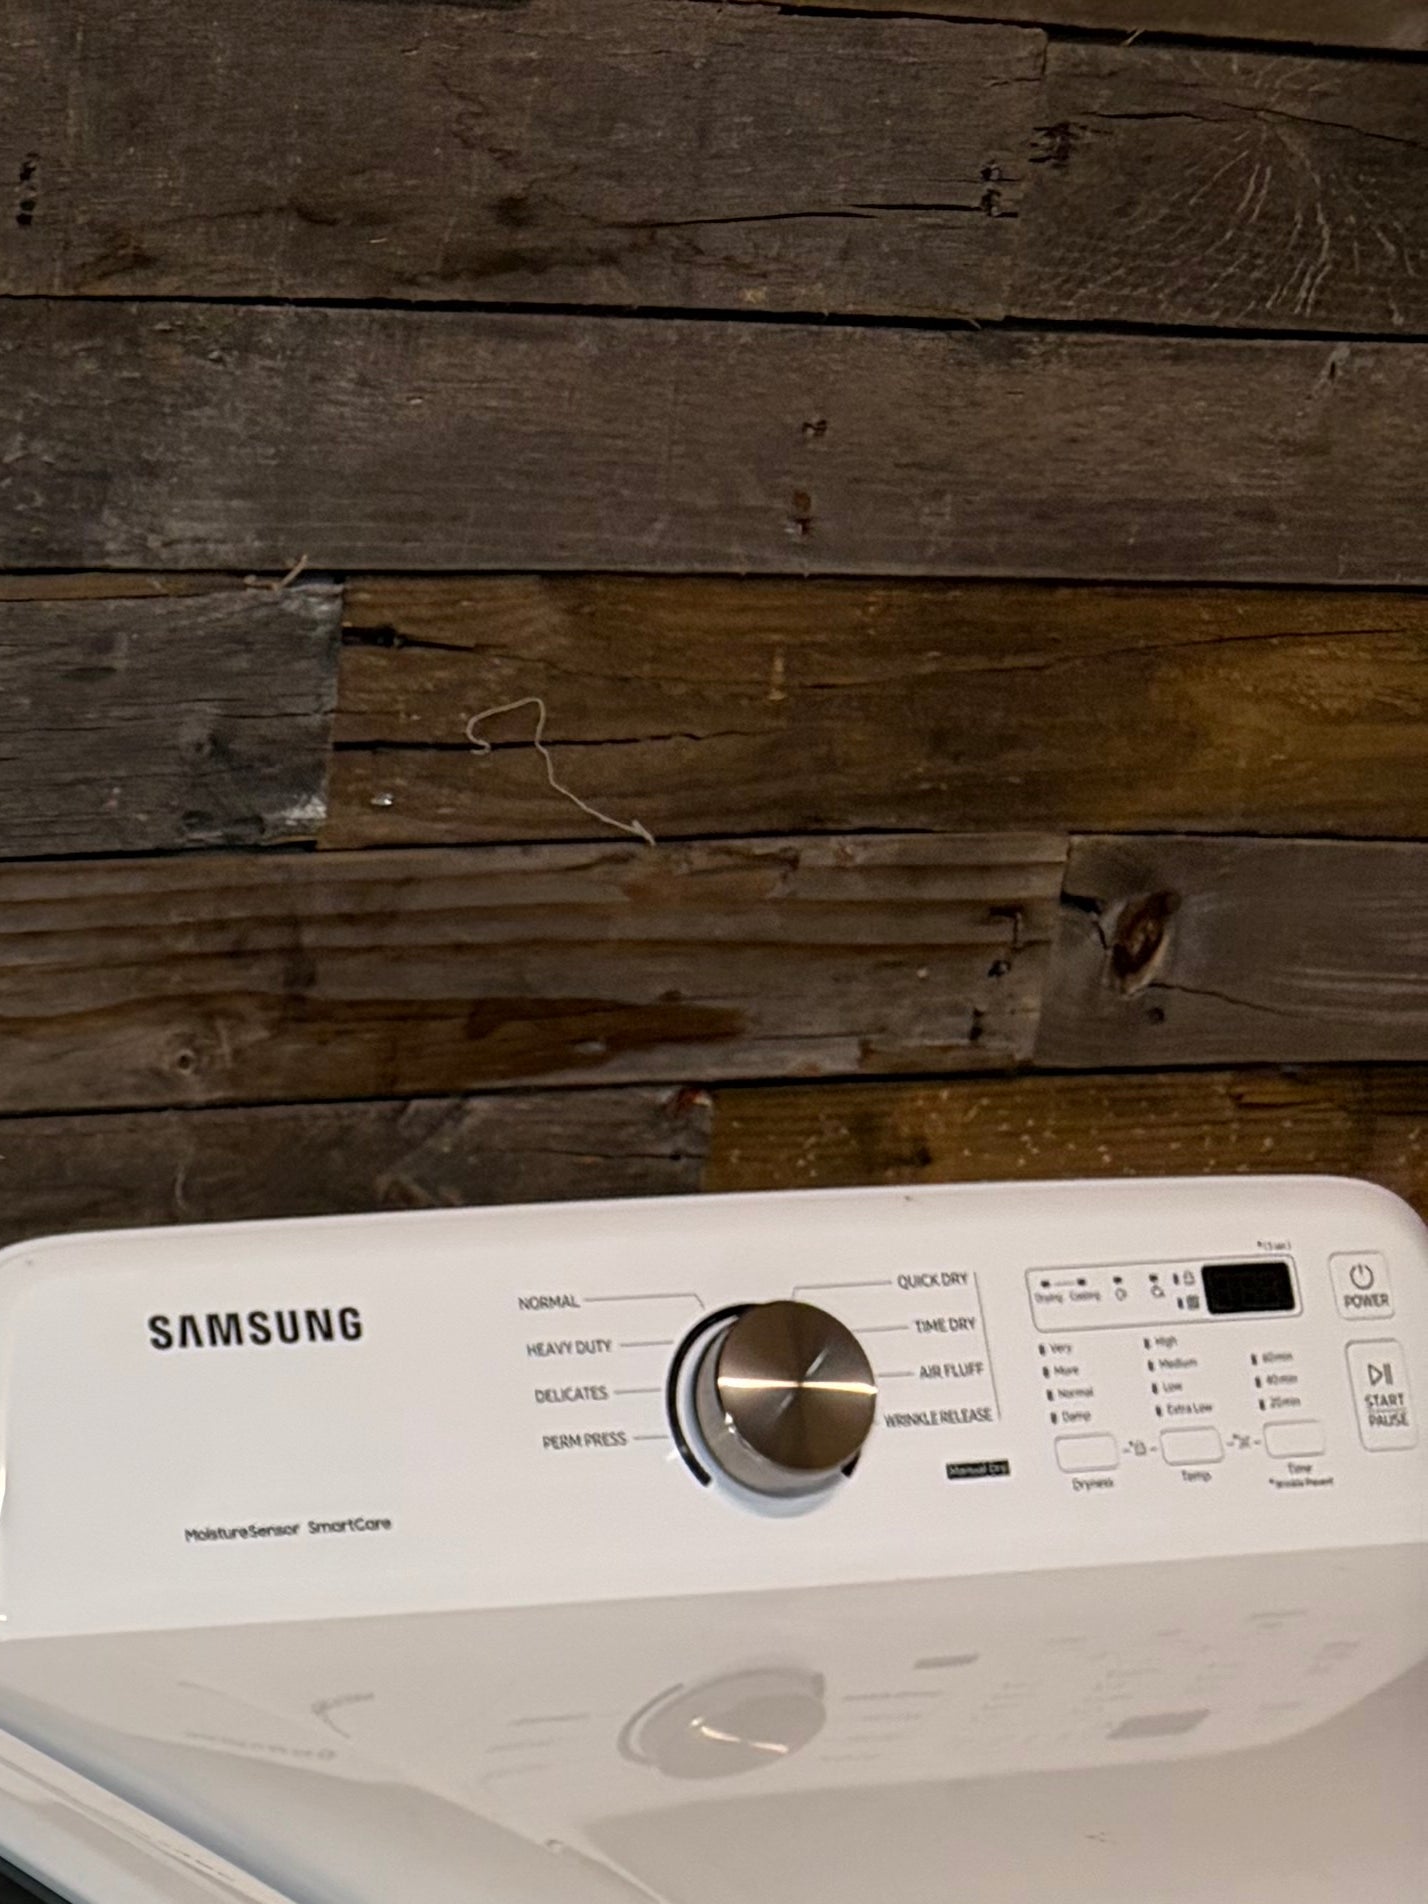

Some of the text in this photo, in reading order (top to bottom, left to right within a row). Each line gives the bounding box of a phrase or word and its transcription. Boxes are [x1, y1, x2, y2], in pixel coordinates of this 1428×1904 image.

[897, 1271, 968, 1290] QUICK DRY
[518, 1294, 581, 1311] NORMAL
[1344, 1293, 1390, 1309] POWER
[147, 1305, 364, 1351] SAMSUNG
[914, 1316, 976, 1334] TIME DRY
[526, 1339, 612, 1358] HEAVY DUTY
[919, 1361, 984, 1380] AIR FLUFF
[534, 1384, 610, 1404] DELICATES
[1364, 1392, 1405, 1408] START
[883, 1407, 994, 1429] WRINKLE RELEASE
[1369, 1412, 1410, 1428] PAUSE
[542, 1430, 628, 1450] PERM PRESS
[184, 1515, 392, 1543] MoistureSensor SmartCare
